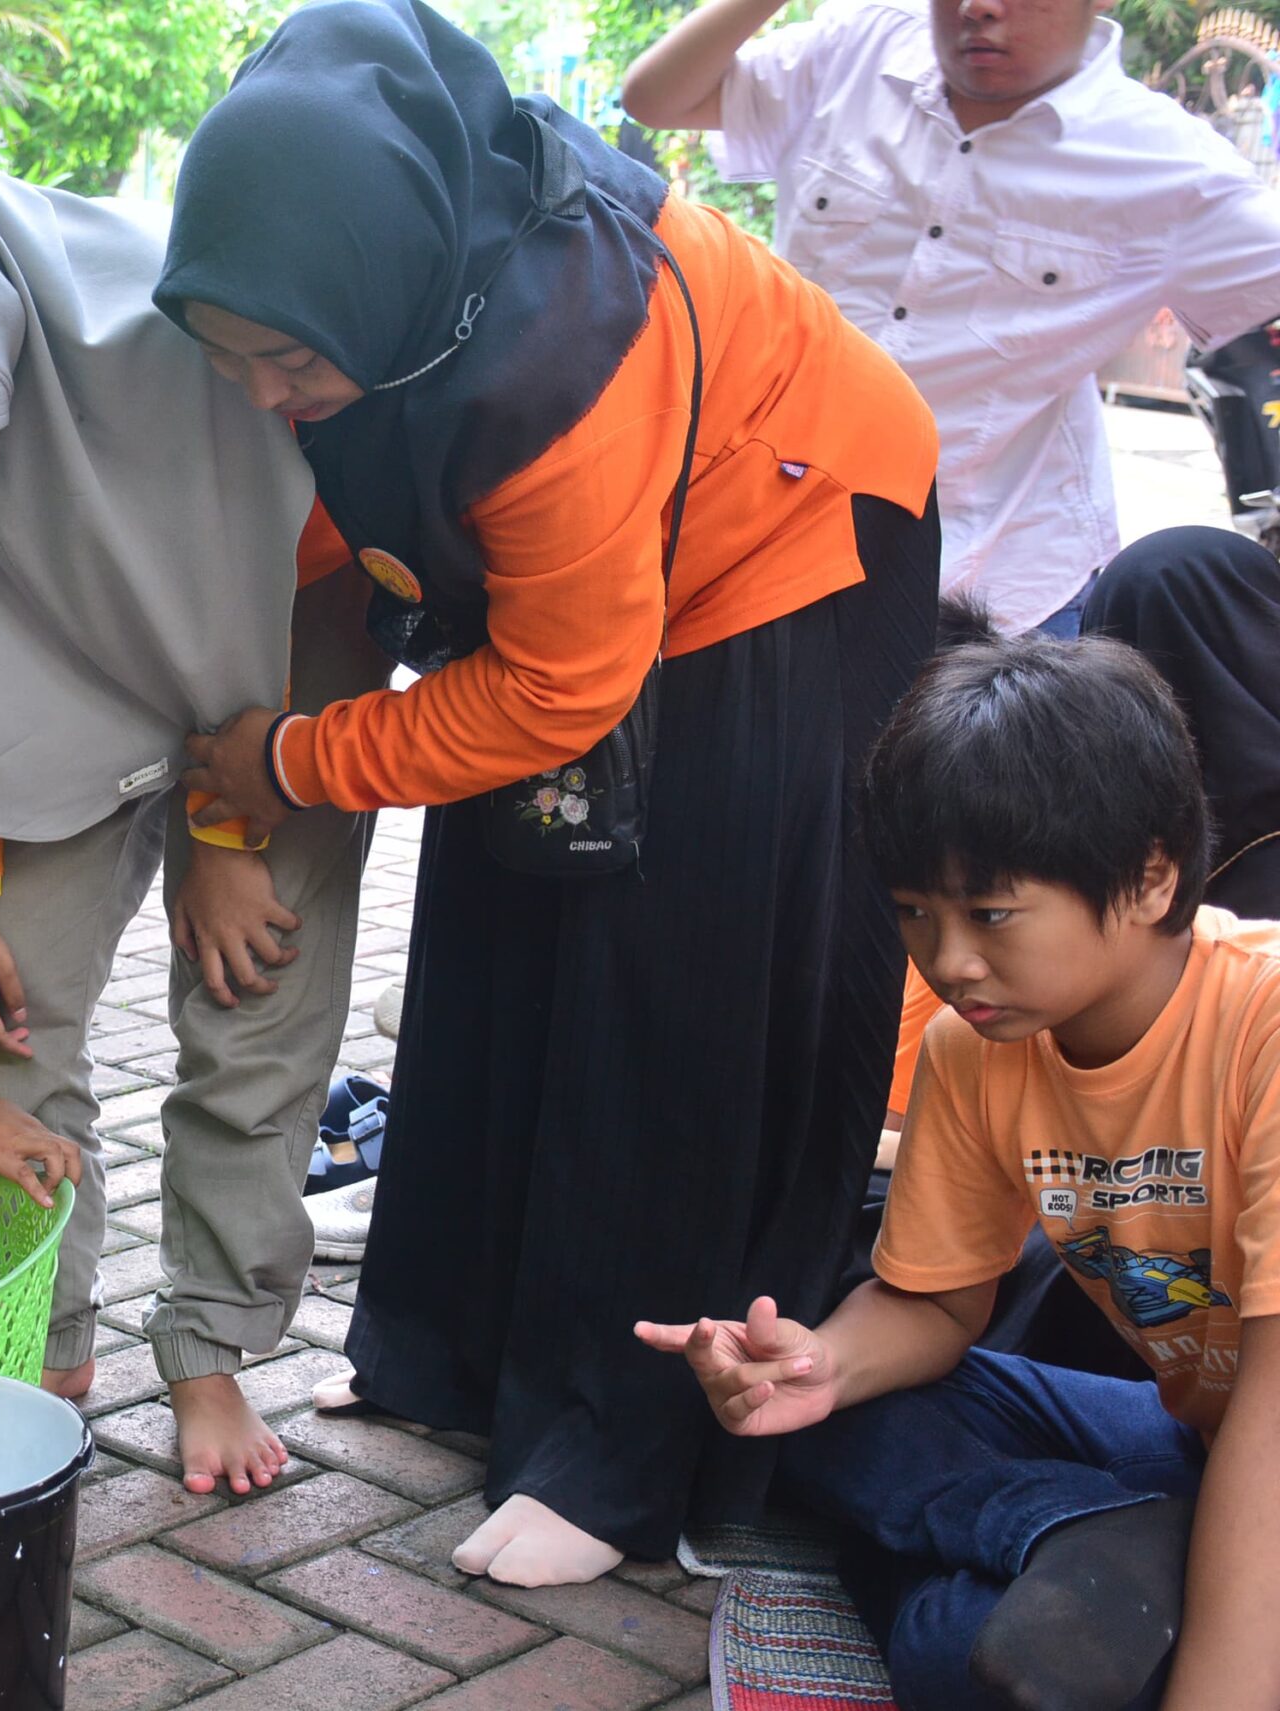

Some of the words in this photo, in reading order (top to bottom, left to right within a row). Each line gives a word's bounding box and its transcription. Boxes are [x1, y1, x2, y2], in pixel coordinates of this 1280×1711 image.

[569, 840, 613, 852] CHIBAO
[1051, 1194, 1070, 1204] HOT
[1091, 1183, 1208, 1212] SPORTS
[1047, 1202, 1073, 1213] RODS!
